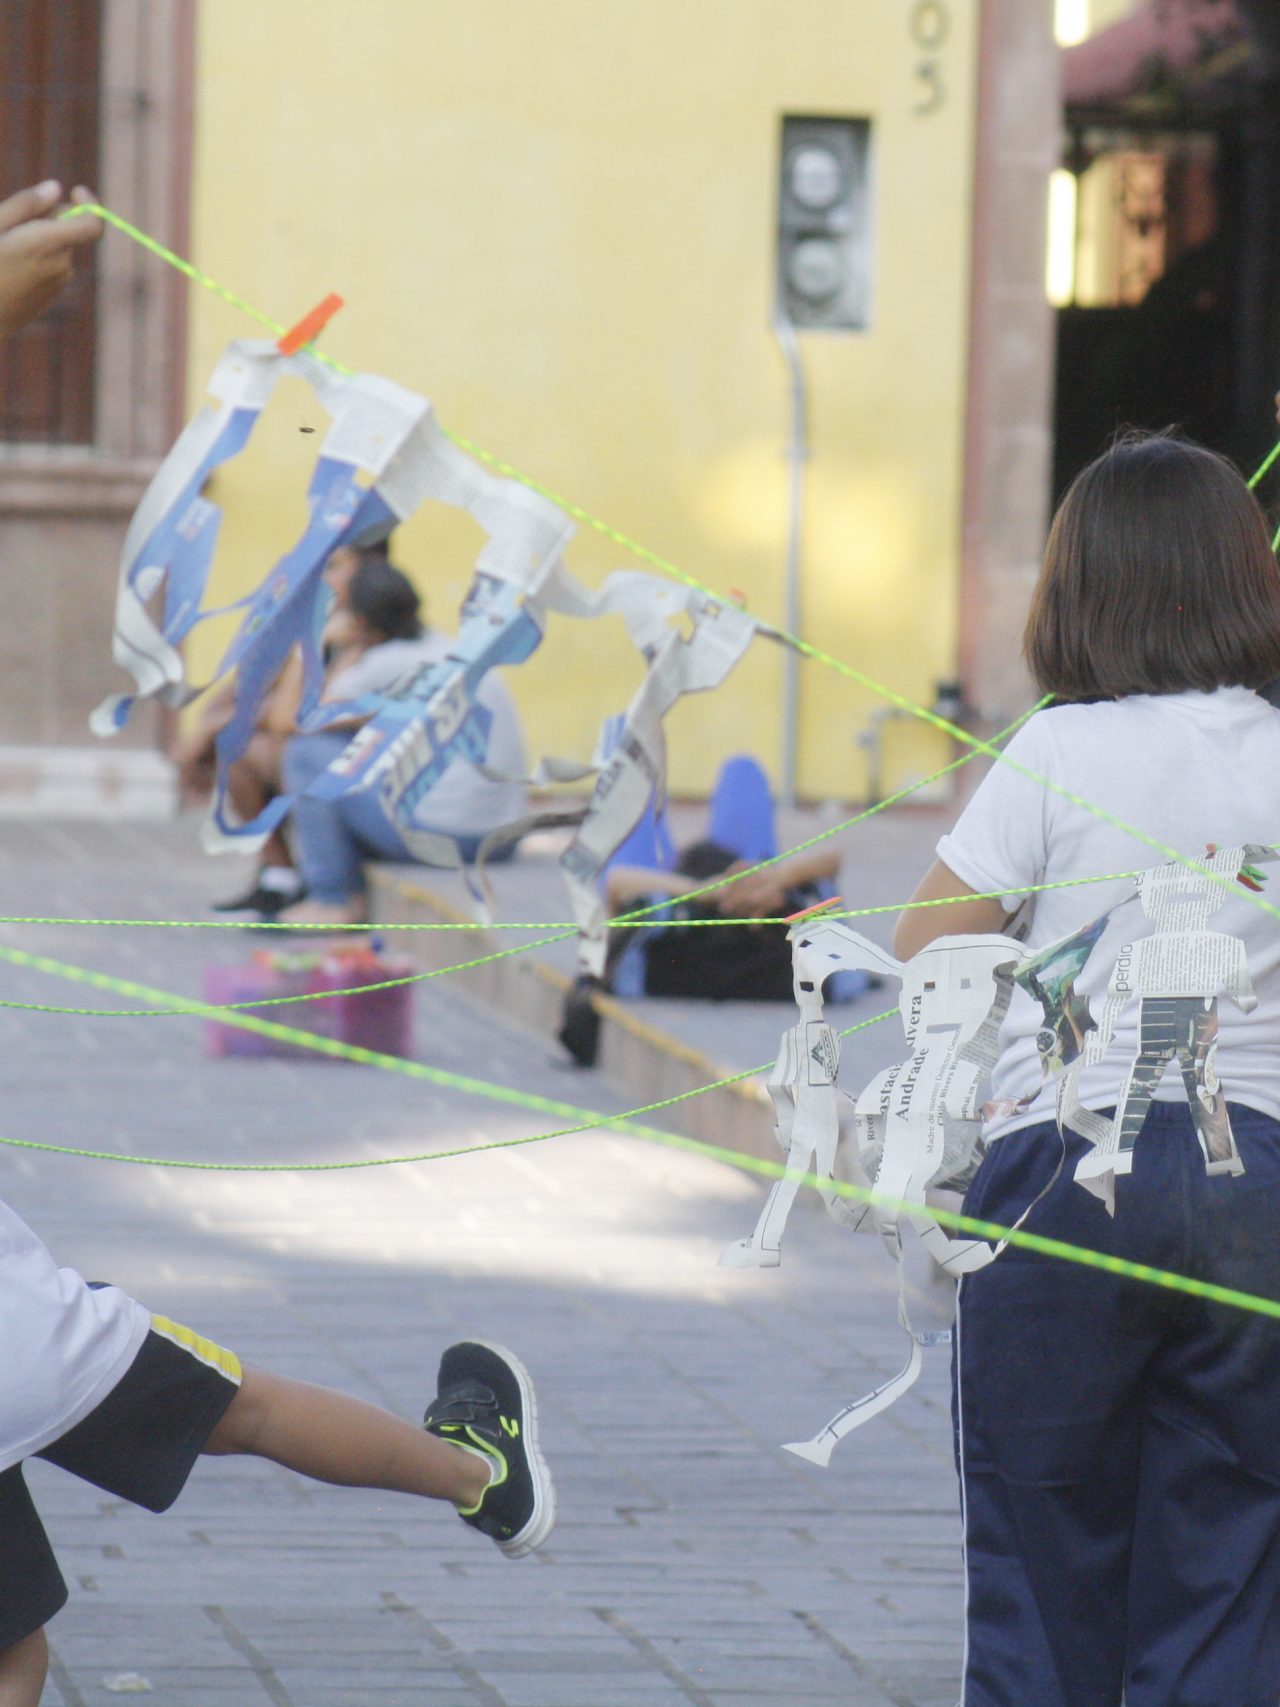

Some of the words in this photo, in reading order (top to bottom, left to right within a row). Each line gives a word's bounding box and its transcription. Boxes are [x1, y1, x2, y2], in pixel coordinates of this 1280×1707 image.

[895, 1047, 929, 1122] Andrade
[928, 1083, 940, 1111] nuestro
[927, 1113, 934, 1124] de
[926, 1126, 935, 1154] Madre
